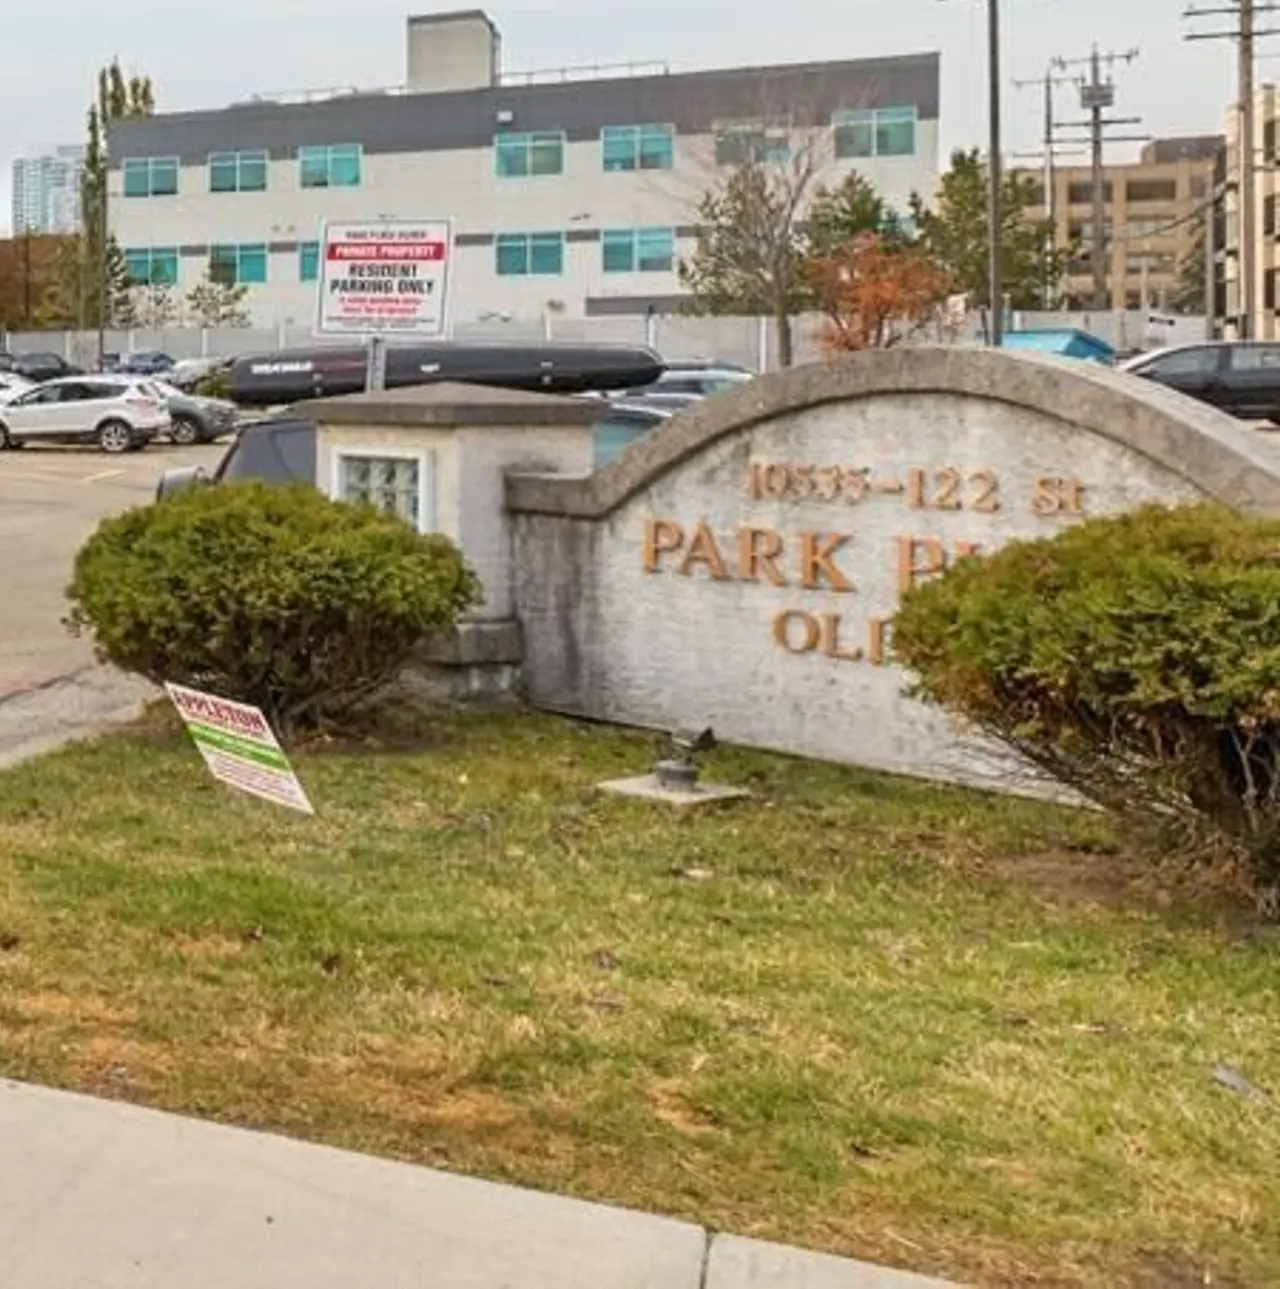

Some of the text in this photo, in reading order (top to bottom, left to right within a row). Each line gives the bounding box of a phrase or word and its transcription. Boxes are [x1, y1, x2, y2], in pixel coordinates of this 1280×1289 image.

[380, 245, 436, 257] PROPERTY
[348, 263, 418, 278] RESIDENT
[330, 279, 434, 294] PARKING ONLY
[1031, 476, 1085, 513] St
[641, 518, 855, 594] PARK
[771, 609, 888, 666] OLI
